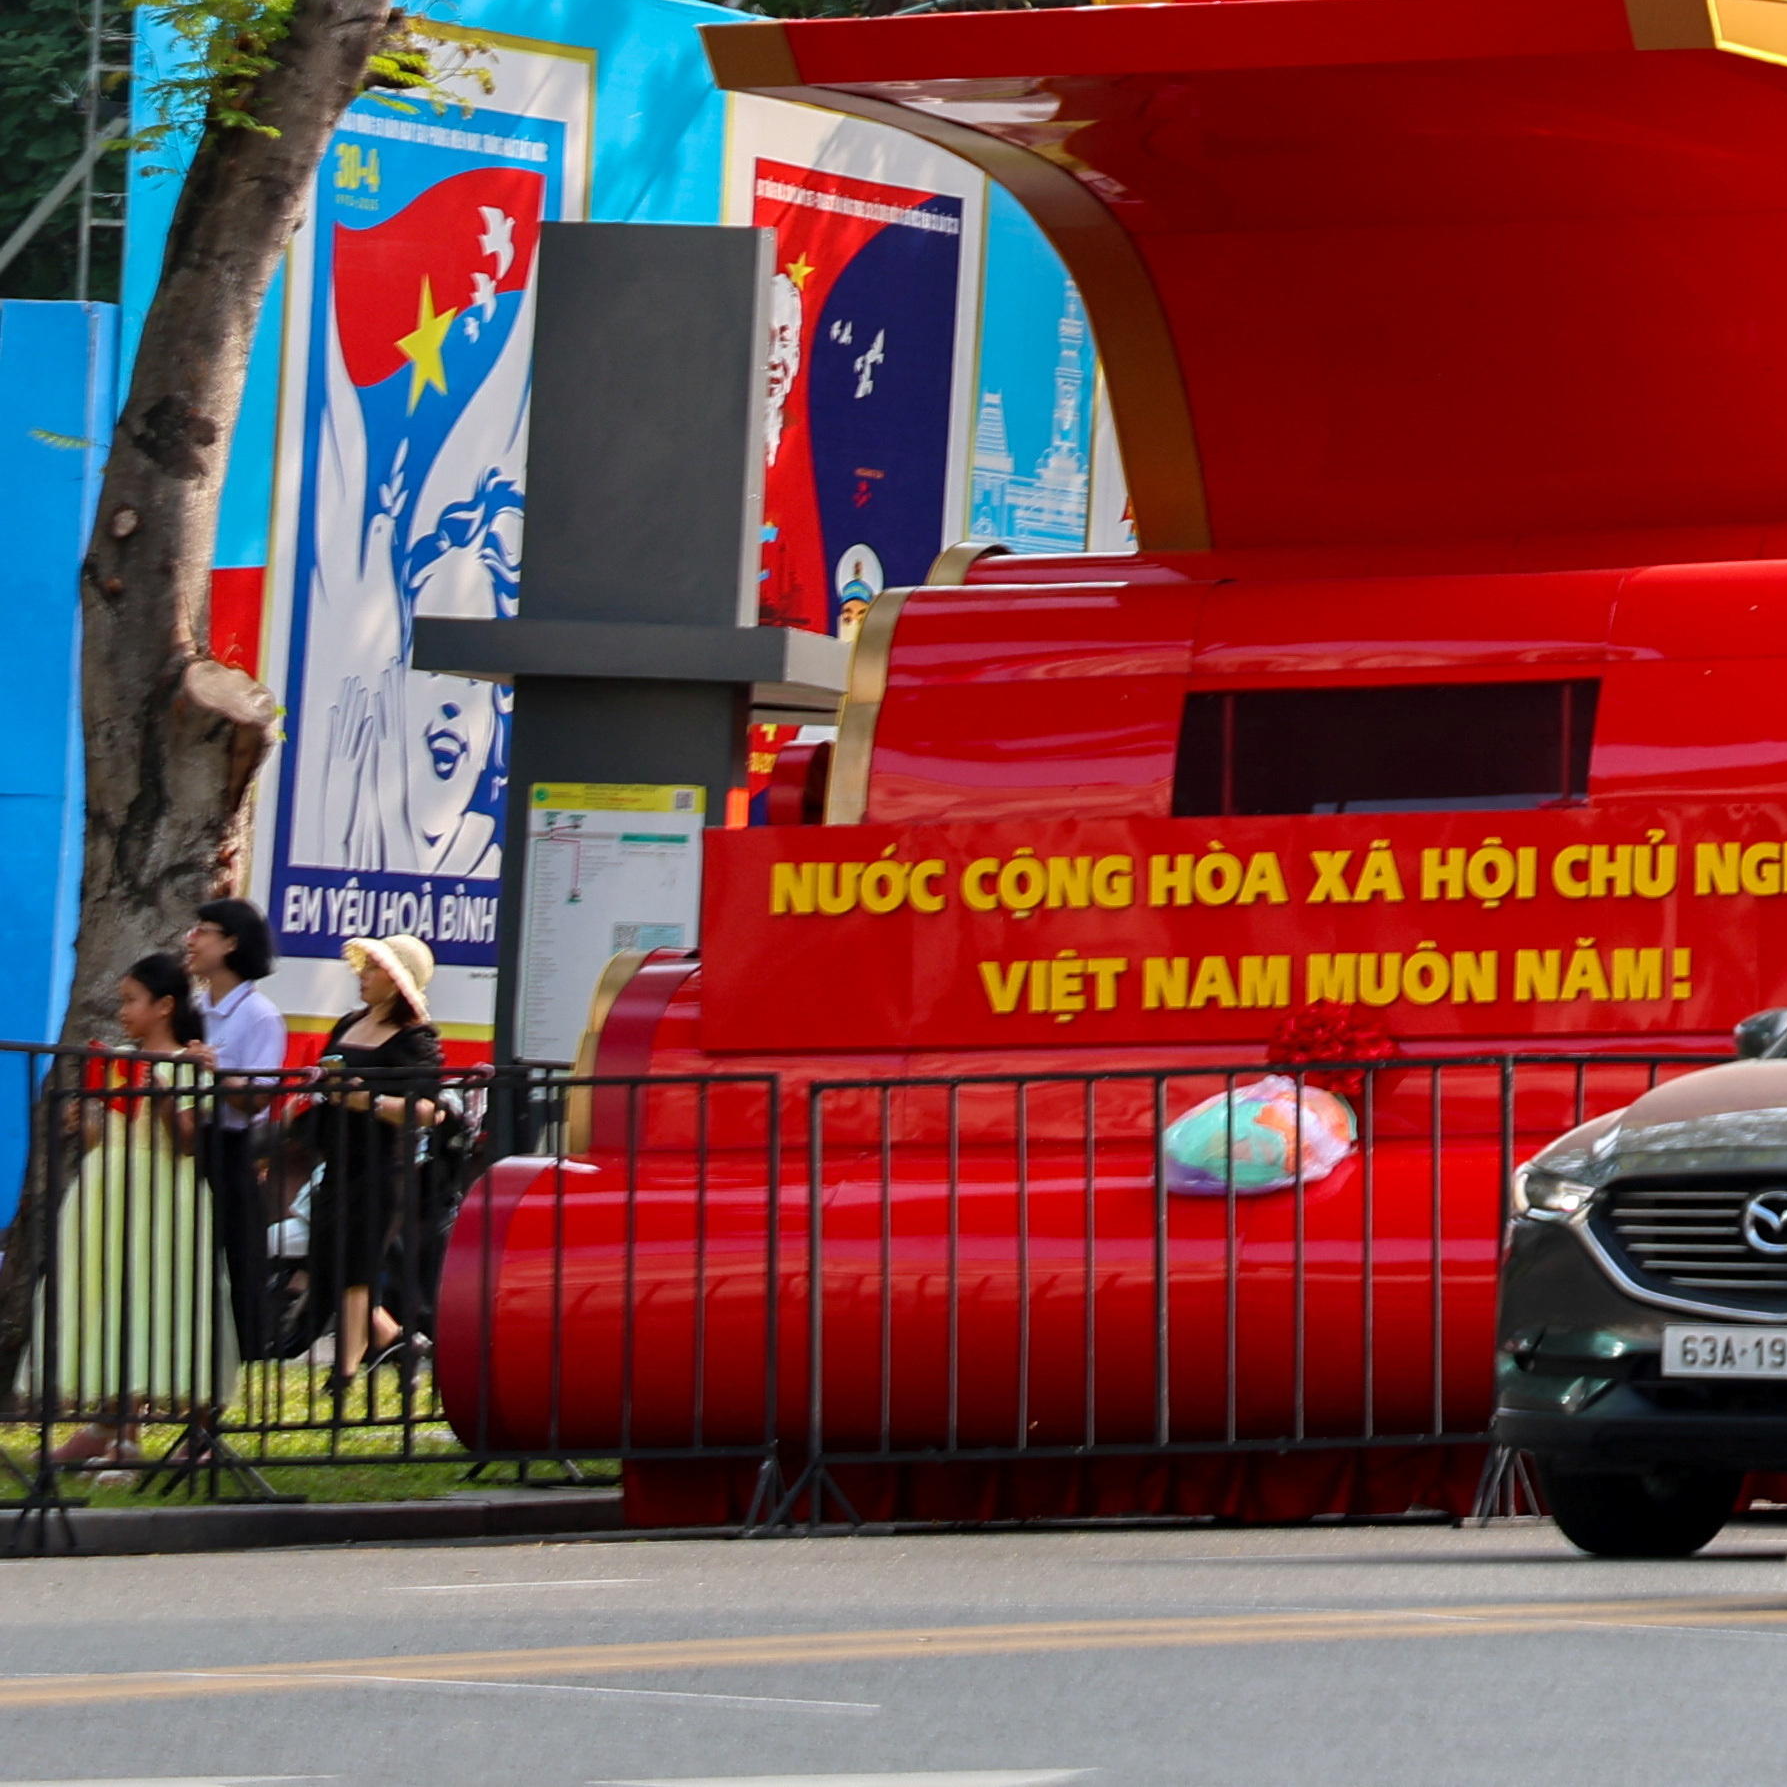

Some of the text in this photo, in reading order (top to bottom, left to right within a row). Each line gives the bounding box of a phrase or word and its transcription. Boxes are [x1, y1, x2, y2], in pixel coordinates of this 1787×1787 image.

[281, 884, 323, 934] EM
[326, 877, 376, 937] YÊU
[436, 883, 498, 944] BÌNH
[770, 842, 946, 915] NƯỚC
[961, 846, 1135, 919] CỘNG
[1147, 840, 1288, 908] HÒA
[1307, 839, 1404, 904] XÃ
[1420, 836, 1538, 909] HỘI
[1551, 828, 1678, 899] CHỦ
[977, 949, 1127, 1024] VIỆT
[1141, 954, 1291, 1010] NAM
[1307, 940, 1498, 1005] MUÔN
